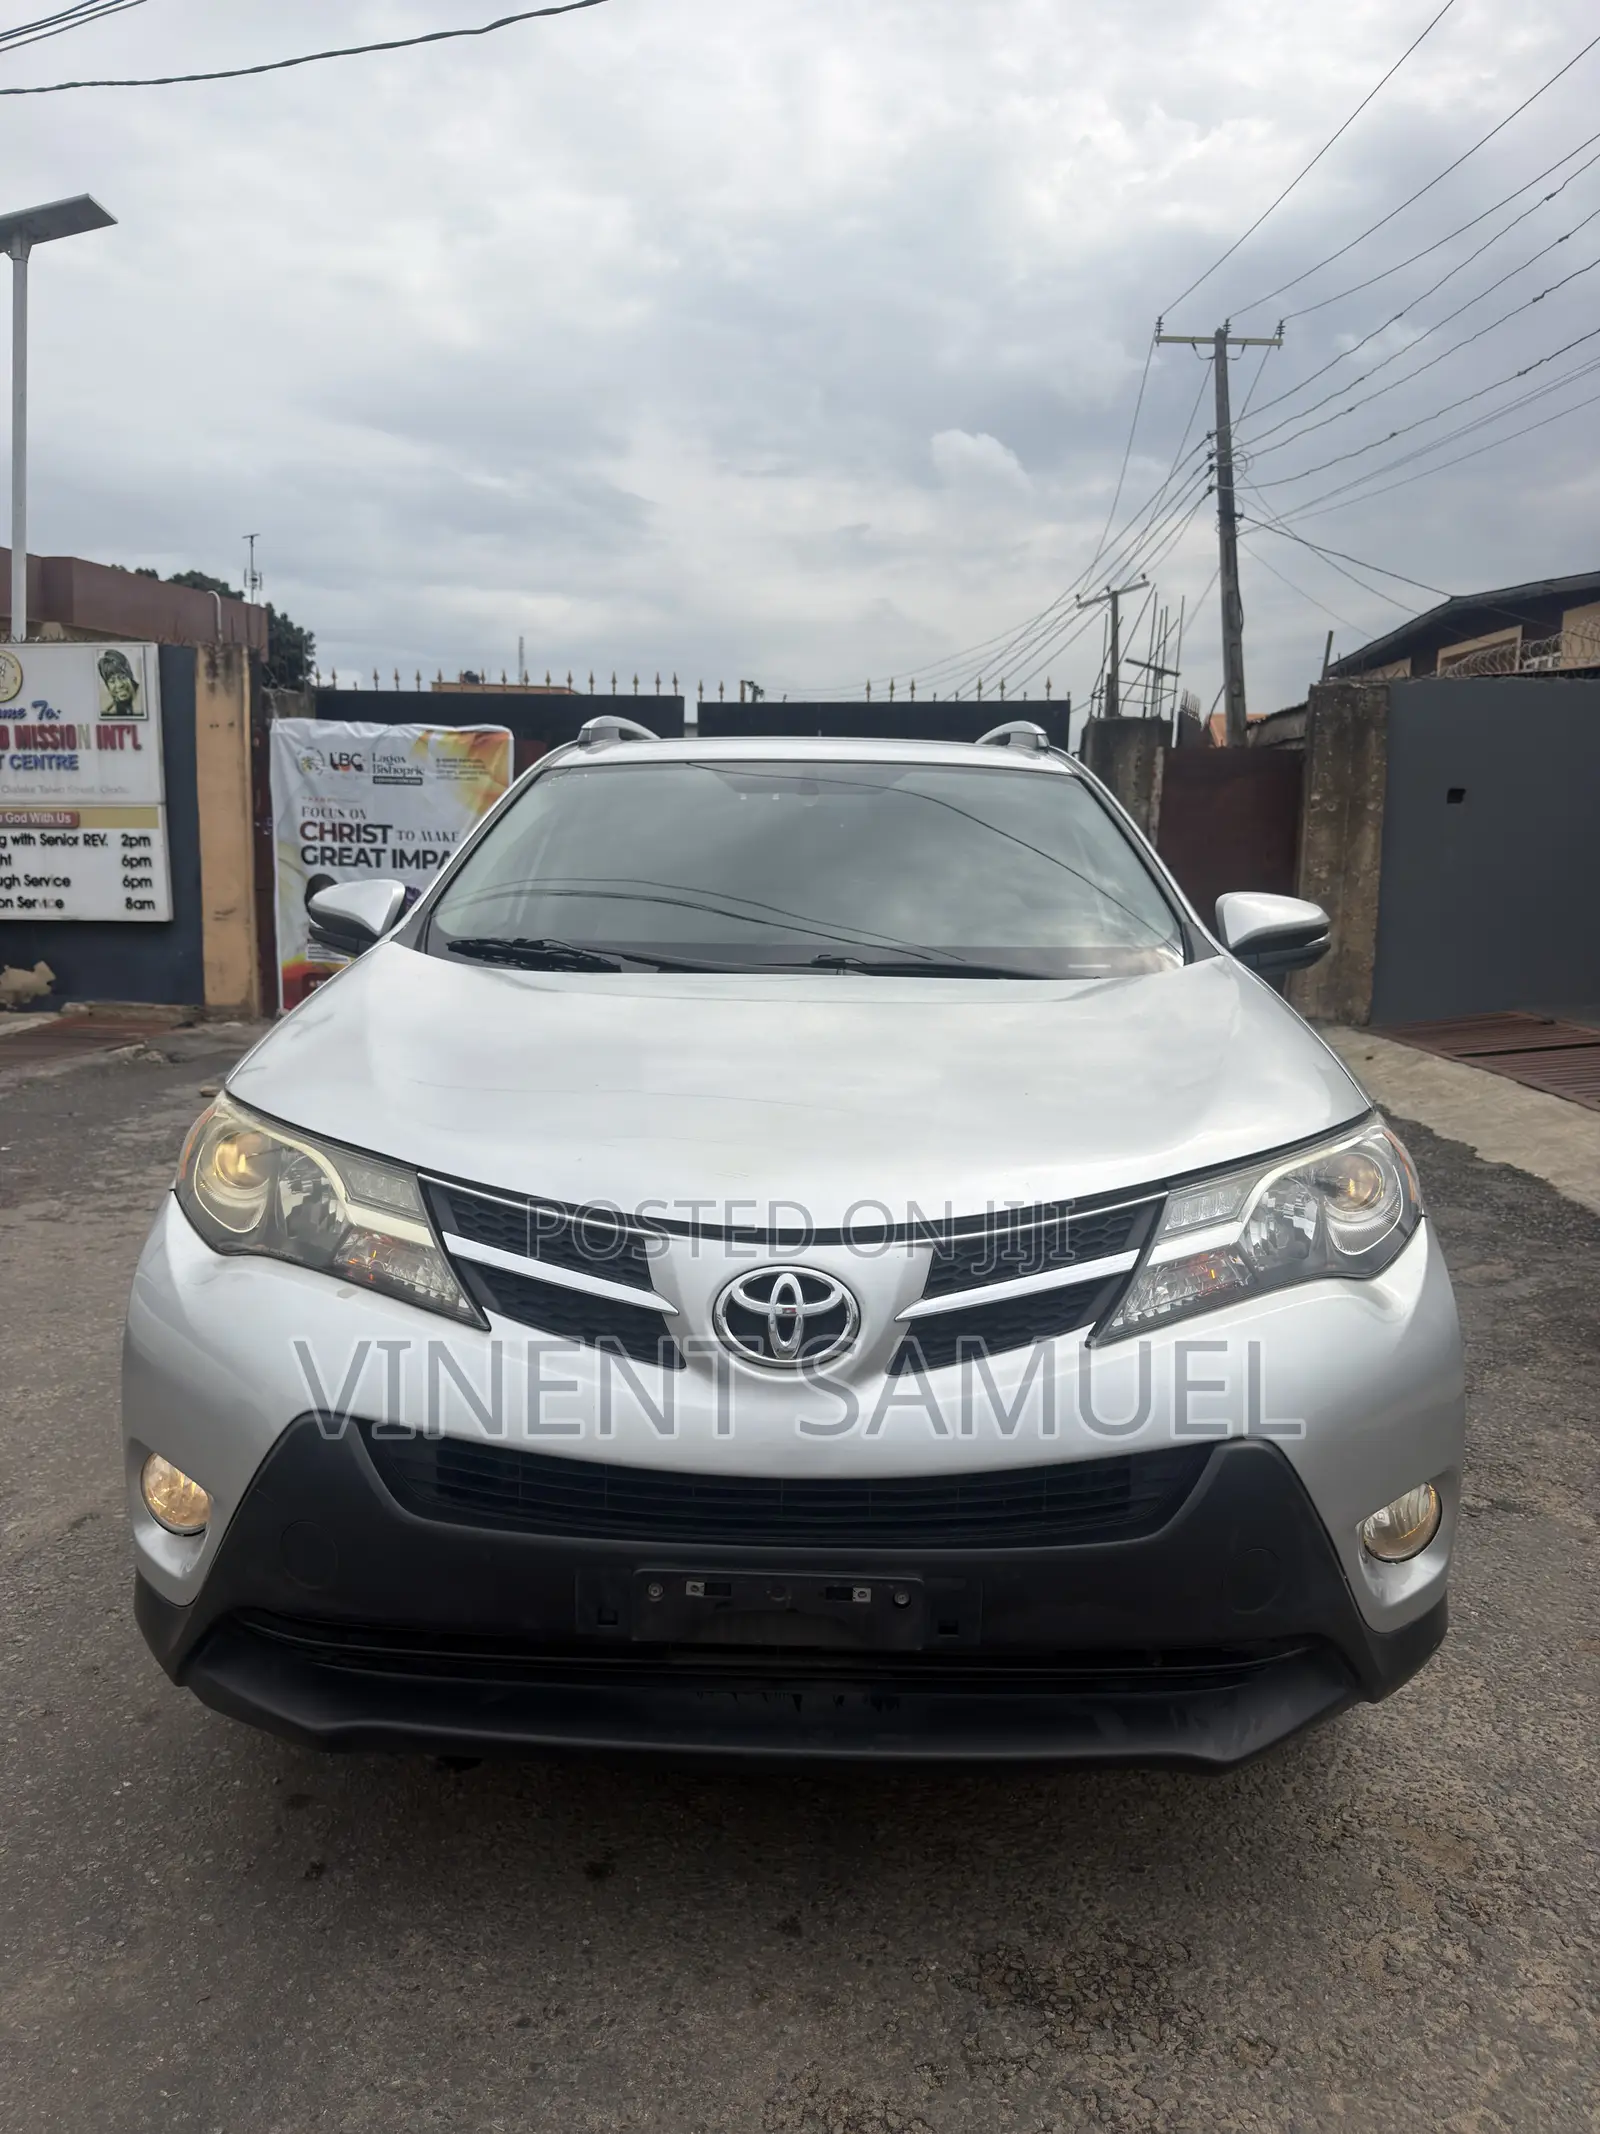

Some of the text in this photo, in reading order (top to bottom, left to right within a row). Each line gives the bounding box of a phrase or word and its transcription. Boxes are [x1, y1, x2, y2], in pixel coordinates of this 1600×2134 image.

[14, 724, 91, 751] MISSION
[9, 754, 80, 771] CENTRE
[5, 812, 28, 824] God
[30, 812, 54, 824] With
[57, 812, 72, 824] Us
[11, 833, 36, 847] with
[40, 833, 79, 848] Senior
[83, 833, 109, 847] REV.
[121, 833, 151, 848] 2pm
[300, 821, 394, 844] CHRIST
[421, 830, 459, 842] MAKE
[122, 854, 153, 869] 6pm
[301, 845, 387, 869] GREAT
[24, 874, 71, 888] Servce
[123, 874, 153, 890] 6pm
[125, 897, 156, 911] 8am
